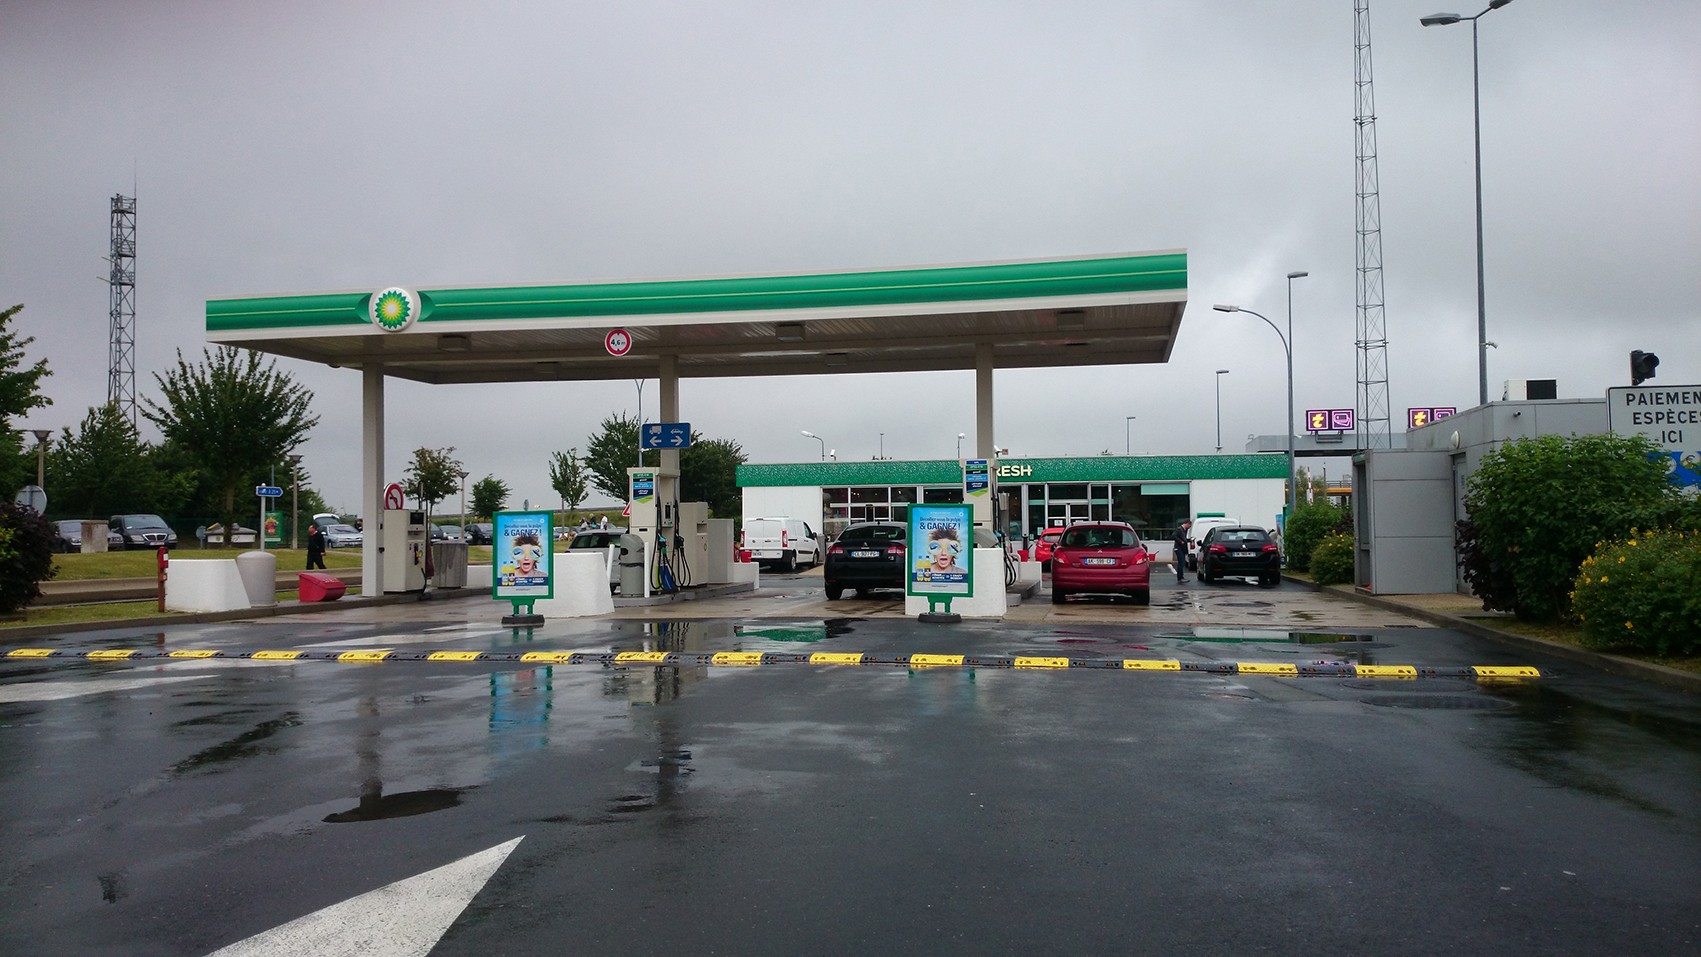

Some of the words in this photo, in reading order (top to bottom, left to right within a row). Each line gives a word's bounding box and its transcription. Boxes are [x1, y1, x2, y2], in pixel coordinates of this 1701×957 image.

[1633, 408, 1701, 425] ESPÈCE
[1661, 430, 1683, 443] ICI
[927, 522, 957, 530] GAGNEZ
[510, 529, 538, 537] GAGNEZ
